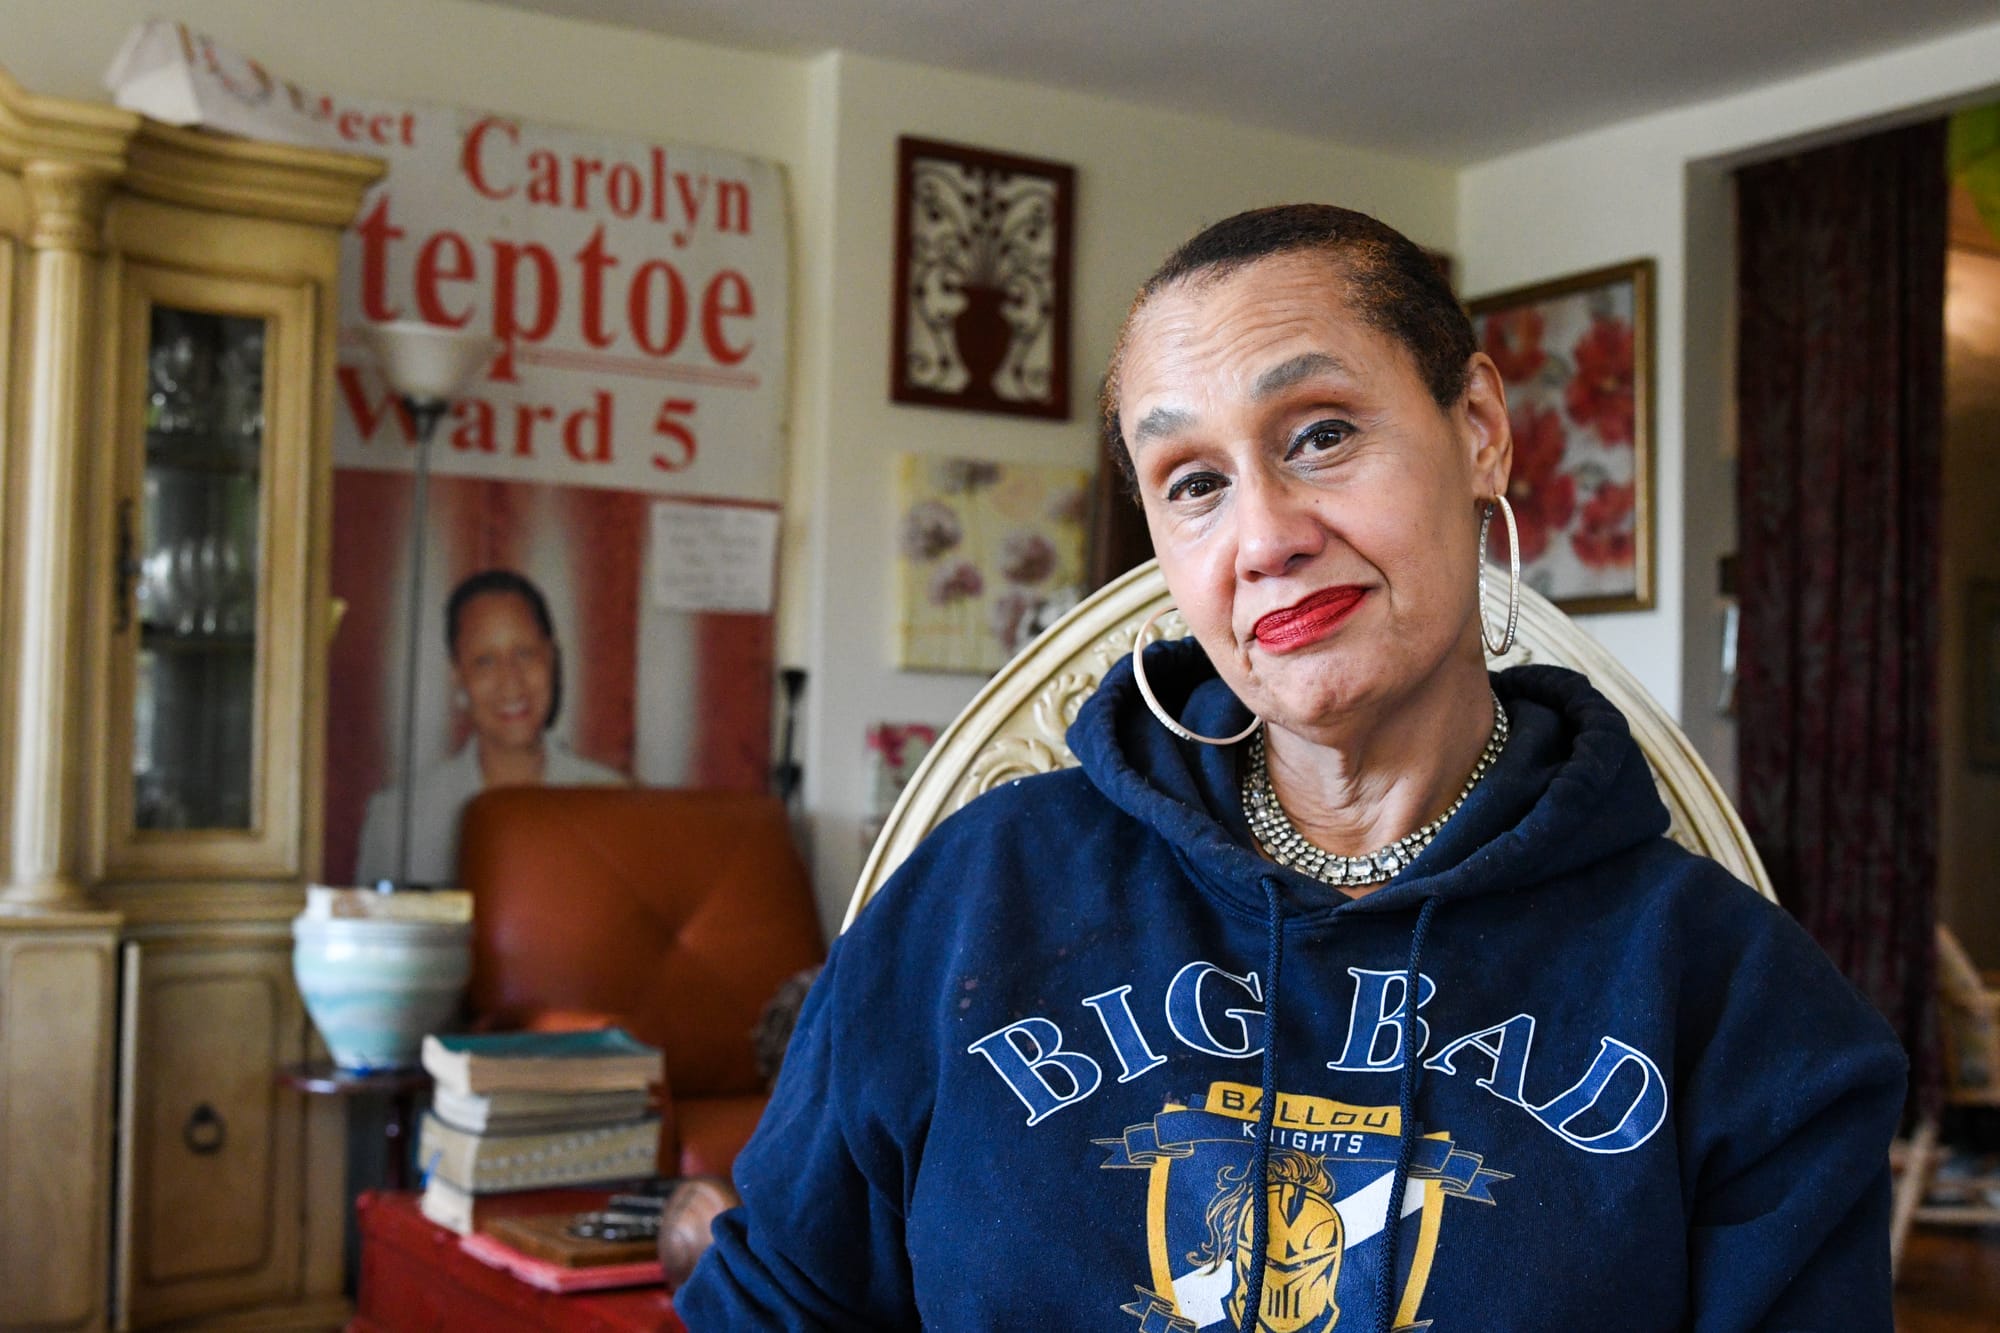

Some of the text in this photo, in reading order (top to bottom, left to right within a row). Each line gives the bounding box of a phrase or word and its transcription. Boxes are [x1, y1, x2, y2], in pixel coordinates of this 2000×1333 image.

[462, 116, 753, 248] Carolyn
[356, 192, 755, 382] teptoe
[337, 363, 698, 473] Ward 5
[967, 960, 1668, 1155] BIG BAD
[1242, 1121, 1364, 1154] KIGHTS
